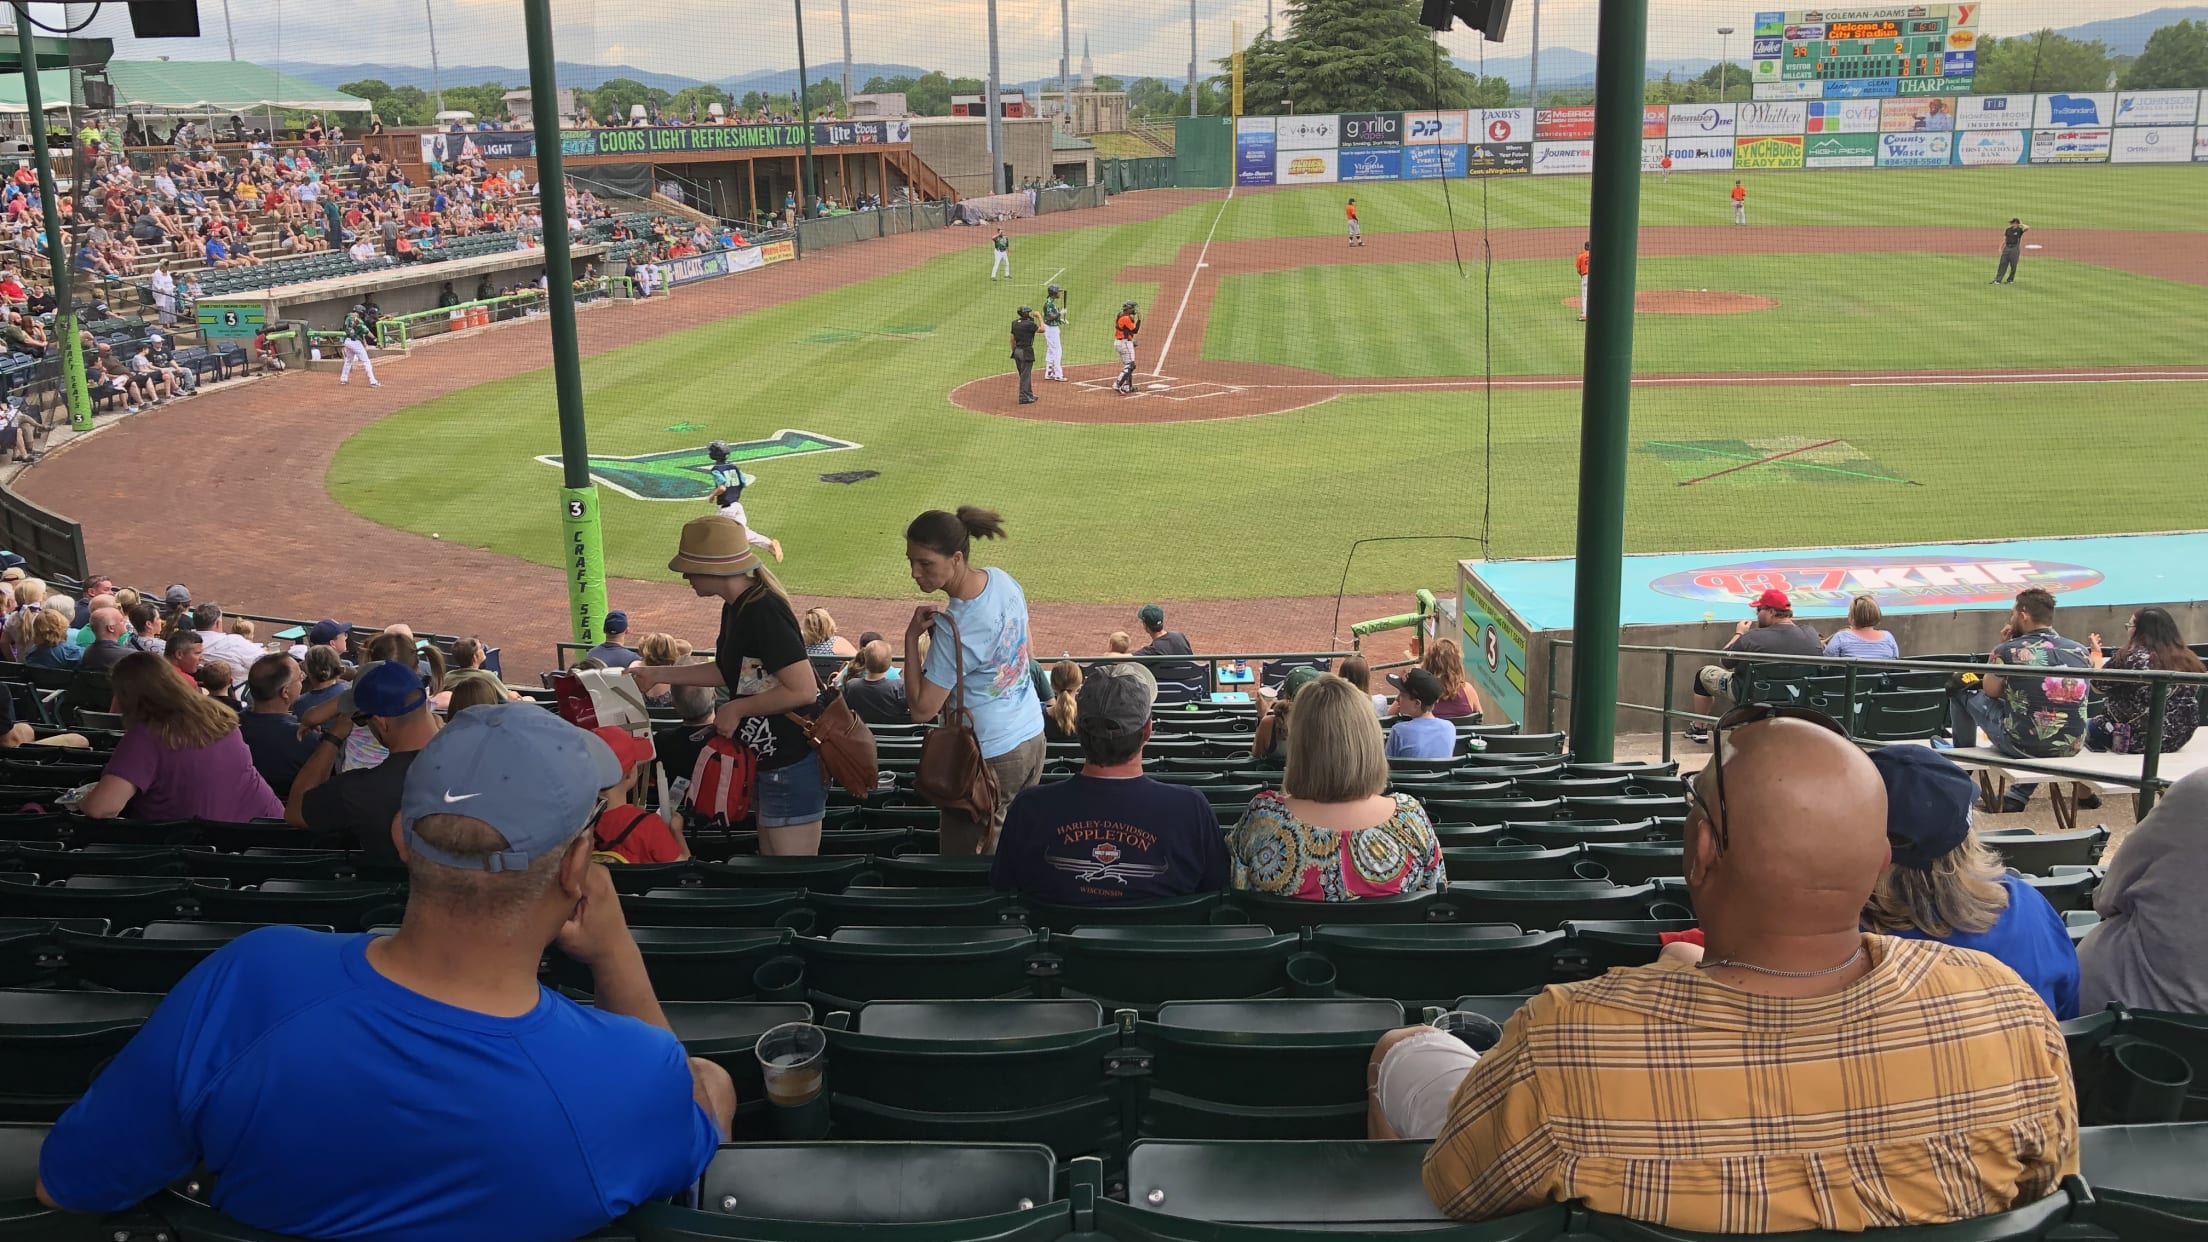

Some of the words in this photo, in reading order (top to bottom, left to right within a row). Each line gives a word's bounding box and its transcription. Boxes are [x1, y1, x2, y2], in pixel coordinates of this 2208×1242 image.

[1833, 23, 1878, 31] Welcome
[1882, 21, 1894, 29] to
[1828, 31, 1850, 39] City
[1854, 29, 1898, 37] Stadium
[1793, 47, 1807, 57] 39
[1895, 42, 1903, 54] 2
[1783, 71, 1812, 79] HILLCATS
[1899, 78, 1945, 92] THARP
[1482, 110, 1521, 120] ZAXBY'S
[1742, 102, 1801, 123] Whitten
[1846, 104, 1878, 120] cvfp
[1347, 115, 1396, 138] gorilla
[599, 130, 645, 152] COORS
[649, 127, 686, 150] LIGHT
[691, 126, 782, 149] REFRESHMENT
[829, 125, 851, 144] Lite
[1883, 134, 1926, 145] County
[484, 143, 513, 155] LIGHT
[1668, 149, 1694, 159] FOOD
[1710, 148, 1732, 158] LION
[1737, 140, 1801, 158] LYNCHBURG
[1809, 147, 1836, 155] HIGH
[1838, 147, 1873, 155] PEAK
[1887, 145, 1925, 157] Waste
[1736, 158, 1775, 167] READY
[1778, 158, 1801, 167] MIX
[226, 312, 236, 326] 3
[75, 414, 83, 423] 3
[570, 501, 582, 517] 3
[573, 531, 588, 594] CRAFT
[1694, 569, 1847, 594] 93.7
[1847, 560, 2041, 588] KHF
[1488, 630, 1497, 667] 3
[1057, 820, 1158, 844] HARLEY-DAVIDSON
[1063, 829, 1151, 852] APPLETON
[1080, 885, 1124, 897] WISCONSIN
